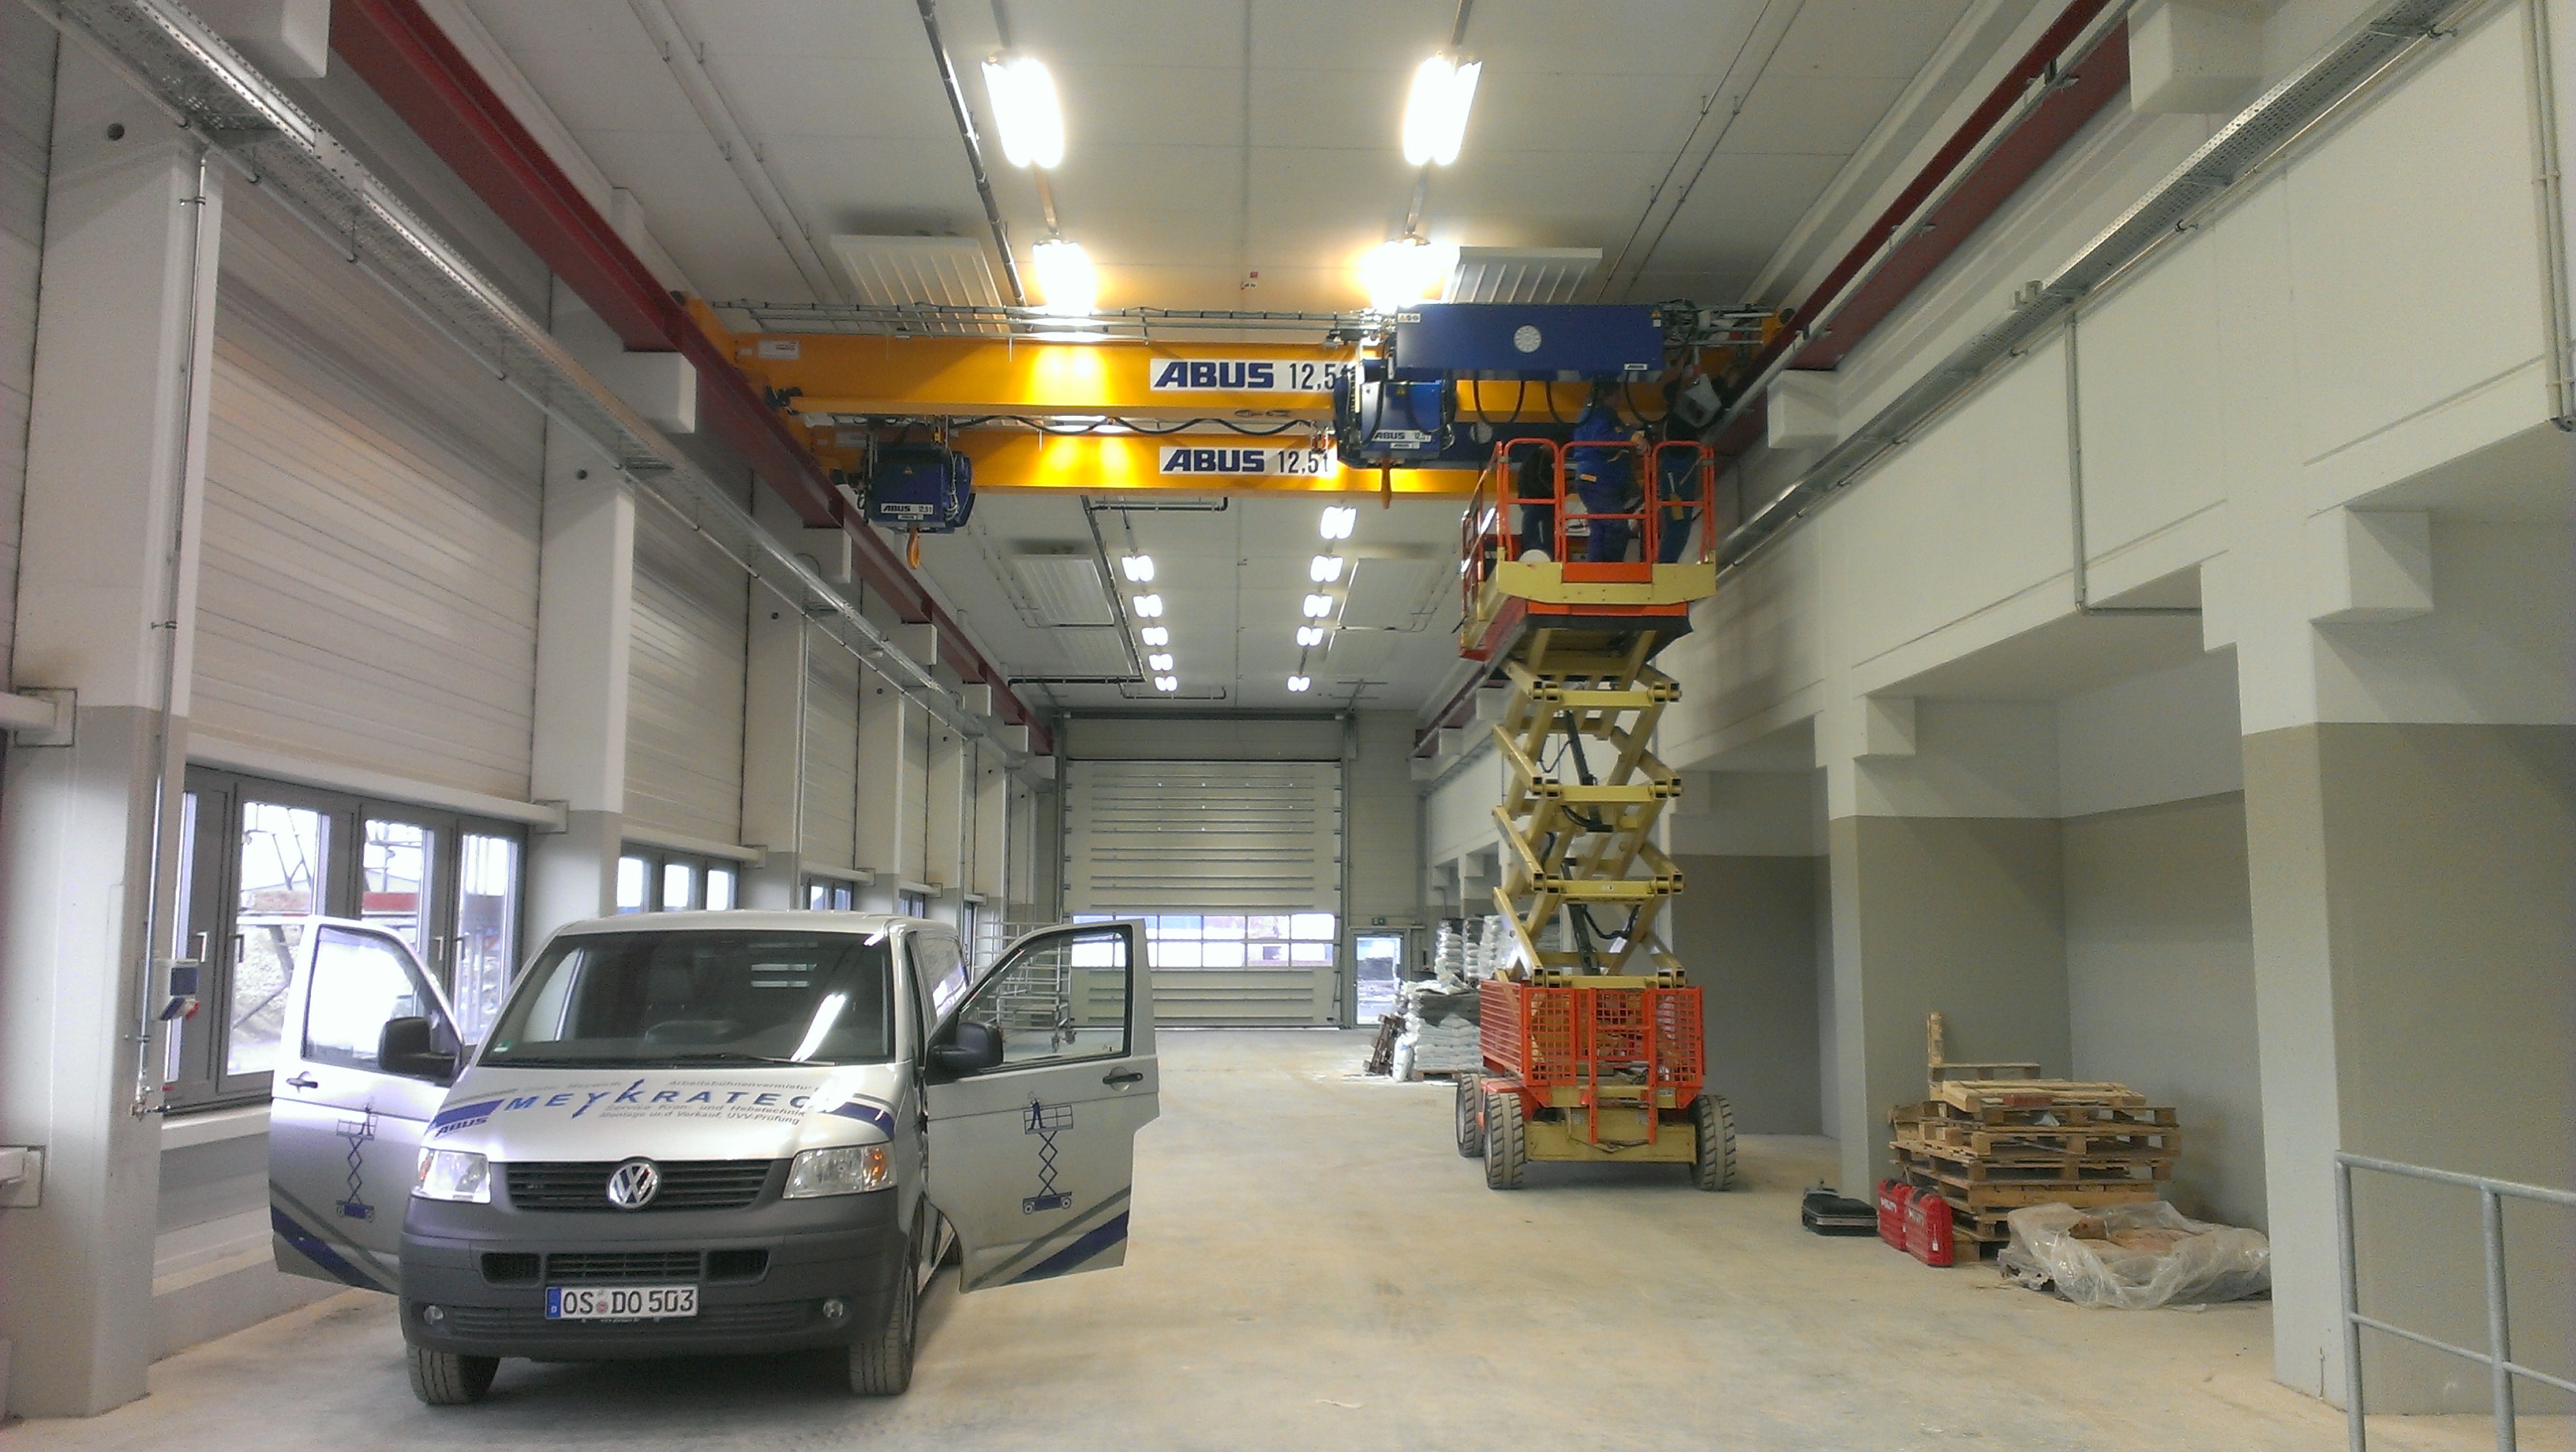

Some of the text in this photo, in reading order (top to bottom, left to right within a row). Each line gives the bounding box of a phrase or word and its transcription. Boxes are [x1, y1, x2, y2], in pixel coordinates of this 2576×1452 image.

[1154, 361, 1275, 388] ABUS
[1163, 449, 1264, 472] ABUS
[434, 1117, 489, 1138] ABUS
[563, 1291, 593, 1314] OS
[611, 1290, 642, 1314] DO
[648, 1289, 695, 1312] 503
